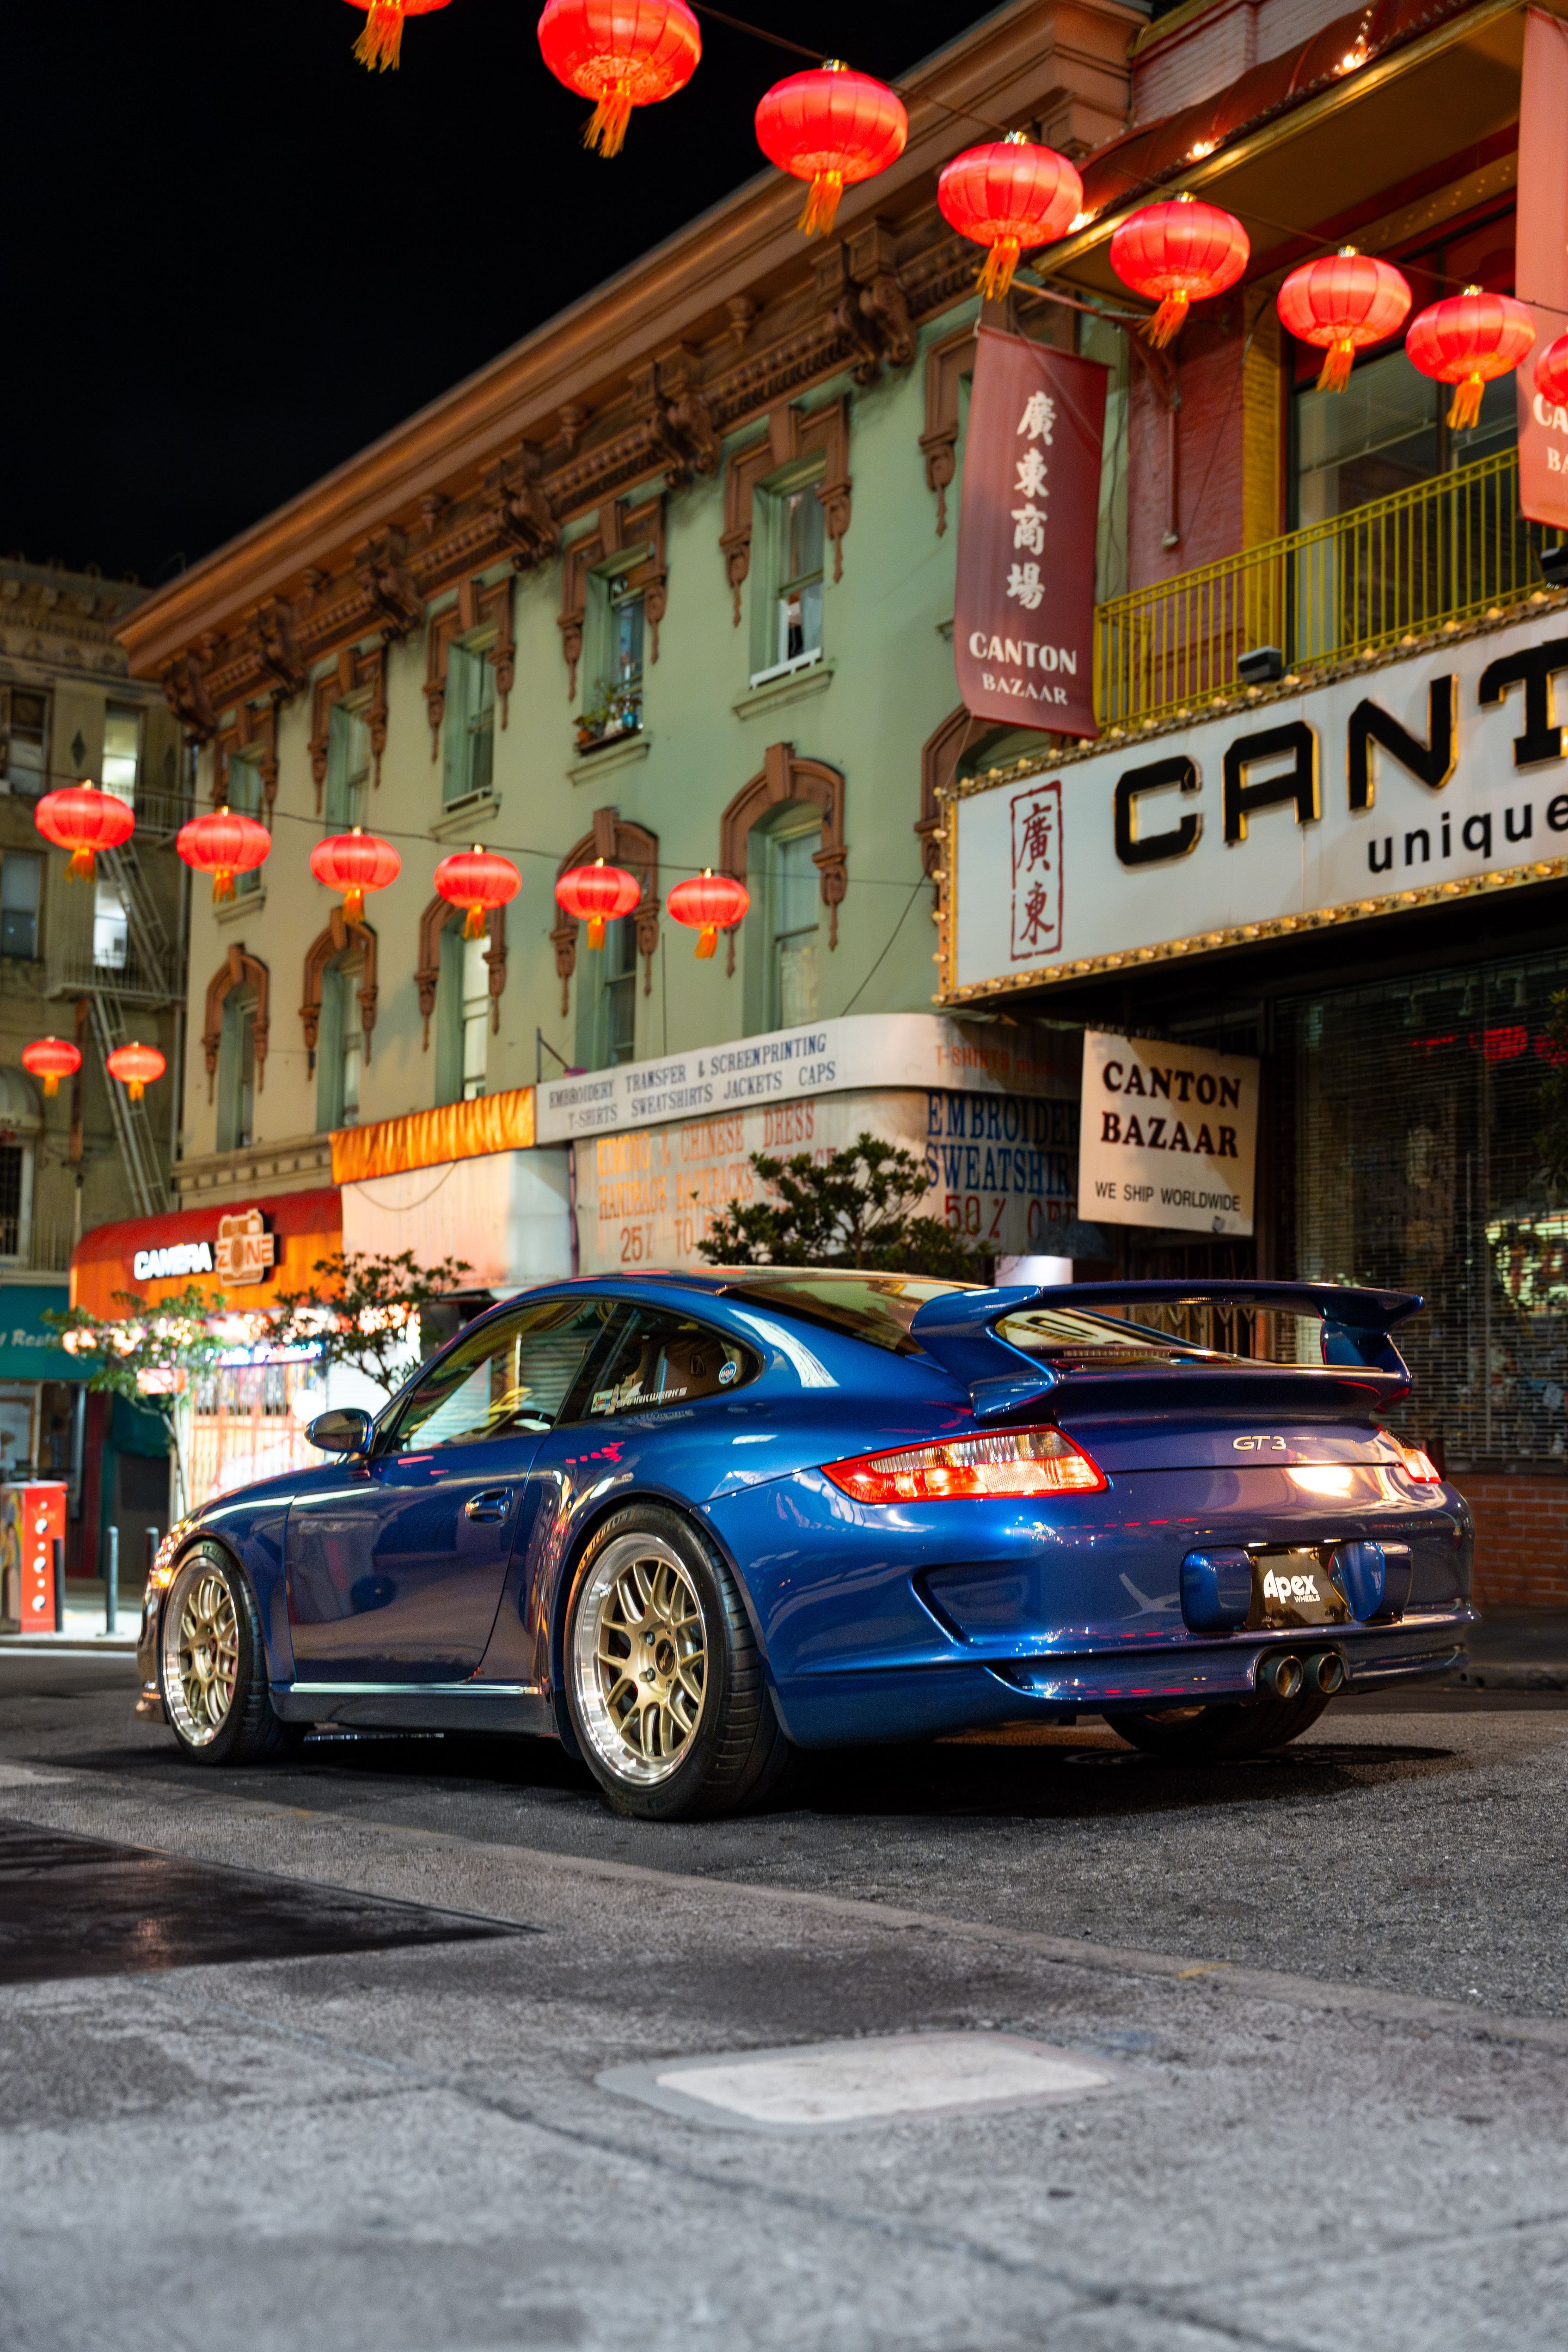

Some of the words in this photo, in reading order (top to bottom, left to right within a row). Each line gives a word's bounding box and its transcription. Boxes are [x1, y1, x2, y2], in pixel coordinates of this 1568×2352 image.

[1006, 390, 1057, 610] 廣東商場
[969, 631, 1076, 676] CANTON
[982, 671, 1069, 706] BAZAAR
[1368, 794, 1568, 874] unique
[1016, 803, 1055, 946] 廣東
[549, 1080, 615, 1110] EMBROIDERY
[626, 1065, 687, 1093] TRANSFER
[569, 1104, 618, 1129] T-SHIRTS
[631, 1083, 713, 1117] SWEATSHIRTS
[723, 1070, 783, 1100] JACKETS
[799, 1061, 836, 1087] CAPS
[1103, 1061, 1241, 1108] CANTON
[597, 1131, 651, 1176] KIMONO
[681, 1113, 745, 1162] CHINESE
[763, 1100, 815, 1148] DRESS
[1100, 1111, 1238, 1158] BAZAAR
[599, 1175, 667, 1220] HANDBAGS
[676, 1162, 755, 1211] BACKPACKS
[926, 1142, 1078, 1197] SWEATSHIR
[1095, 1181, 1116, 1199] WE
[1124, 1184, 1154, 1203] SHIP
[1161, 1187, 1241, 1212] WORLDWIDE
[674, 1215, 694, 1259] TO
[134, 1242, 212, 1280] CAMERA
[1233, 1435, 1287, 1451] GT3
[1294, 1593, 1320, 1603] WHEELS
